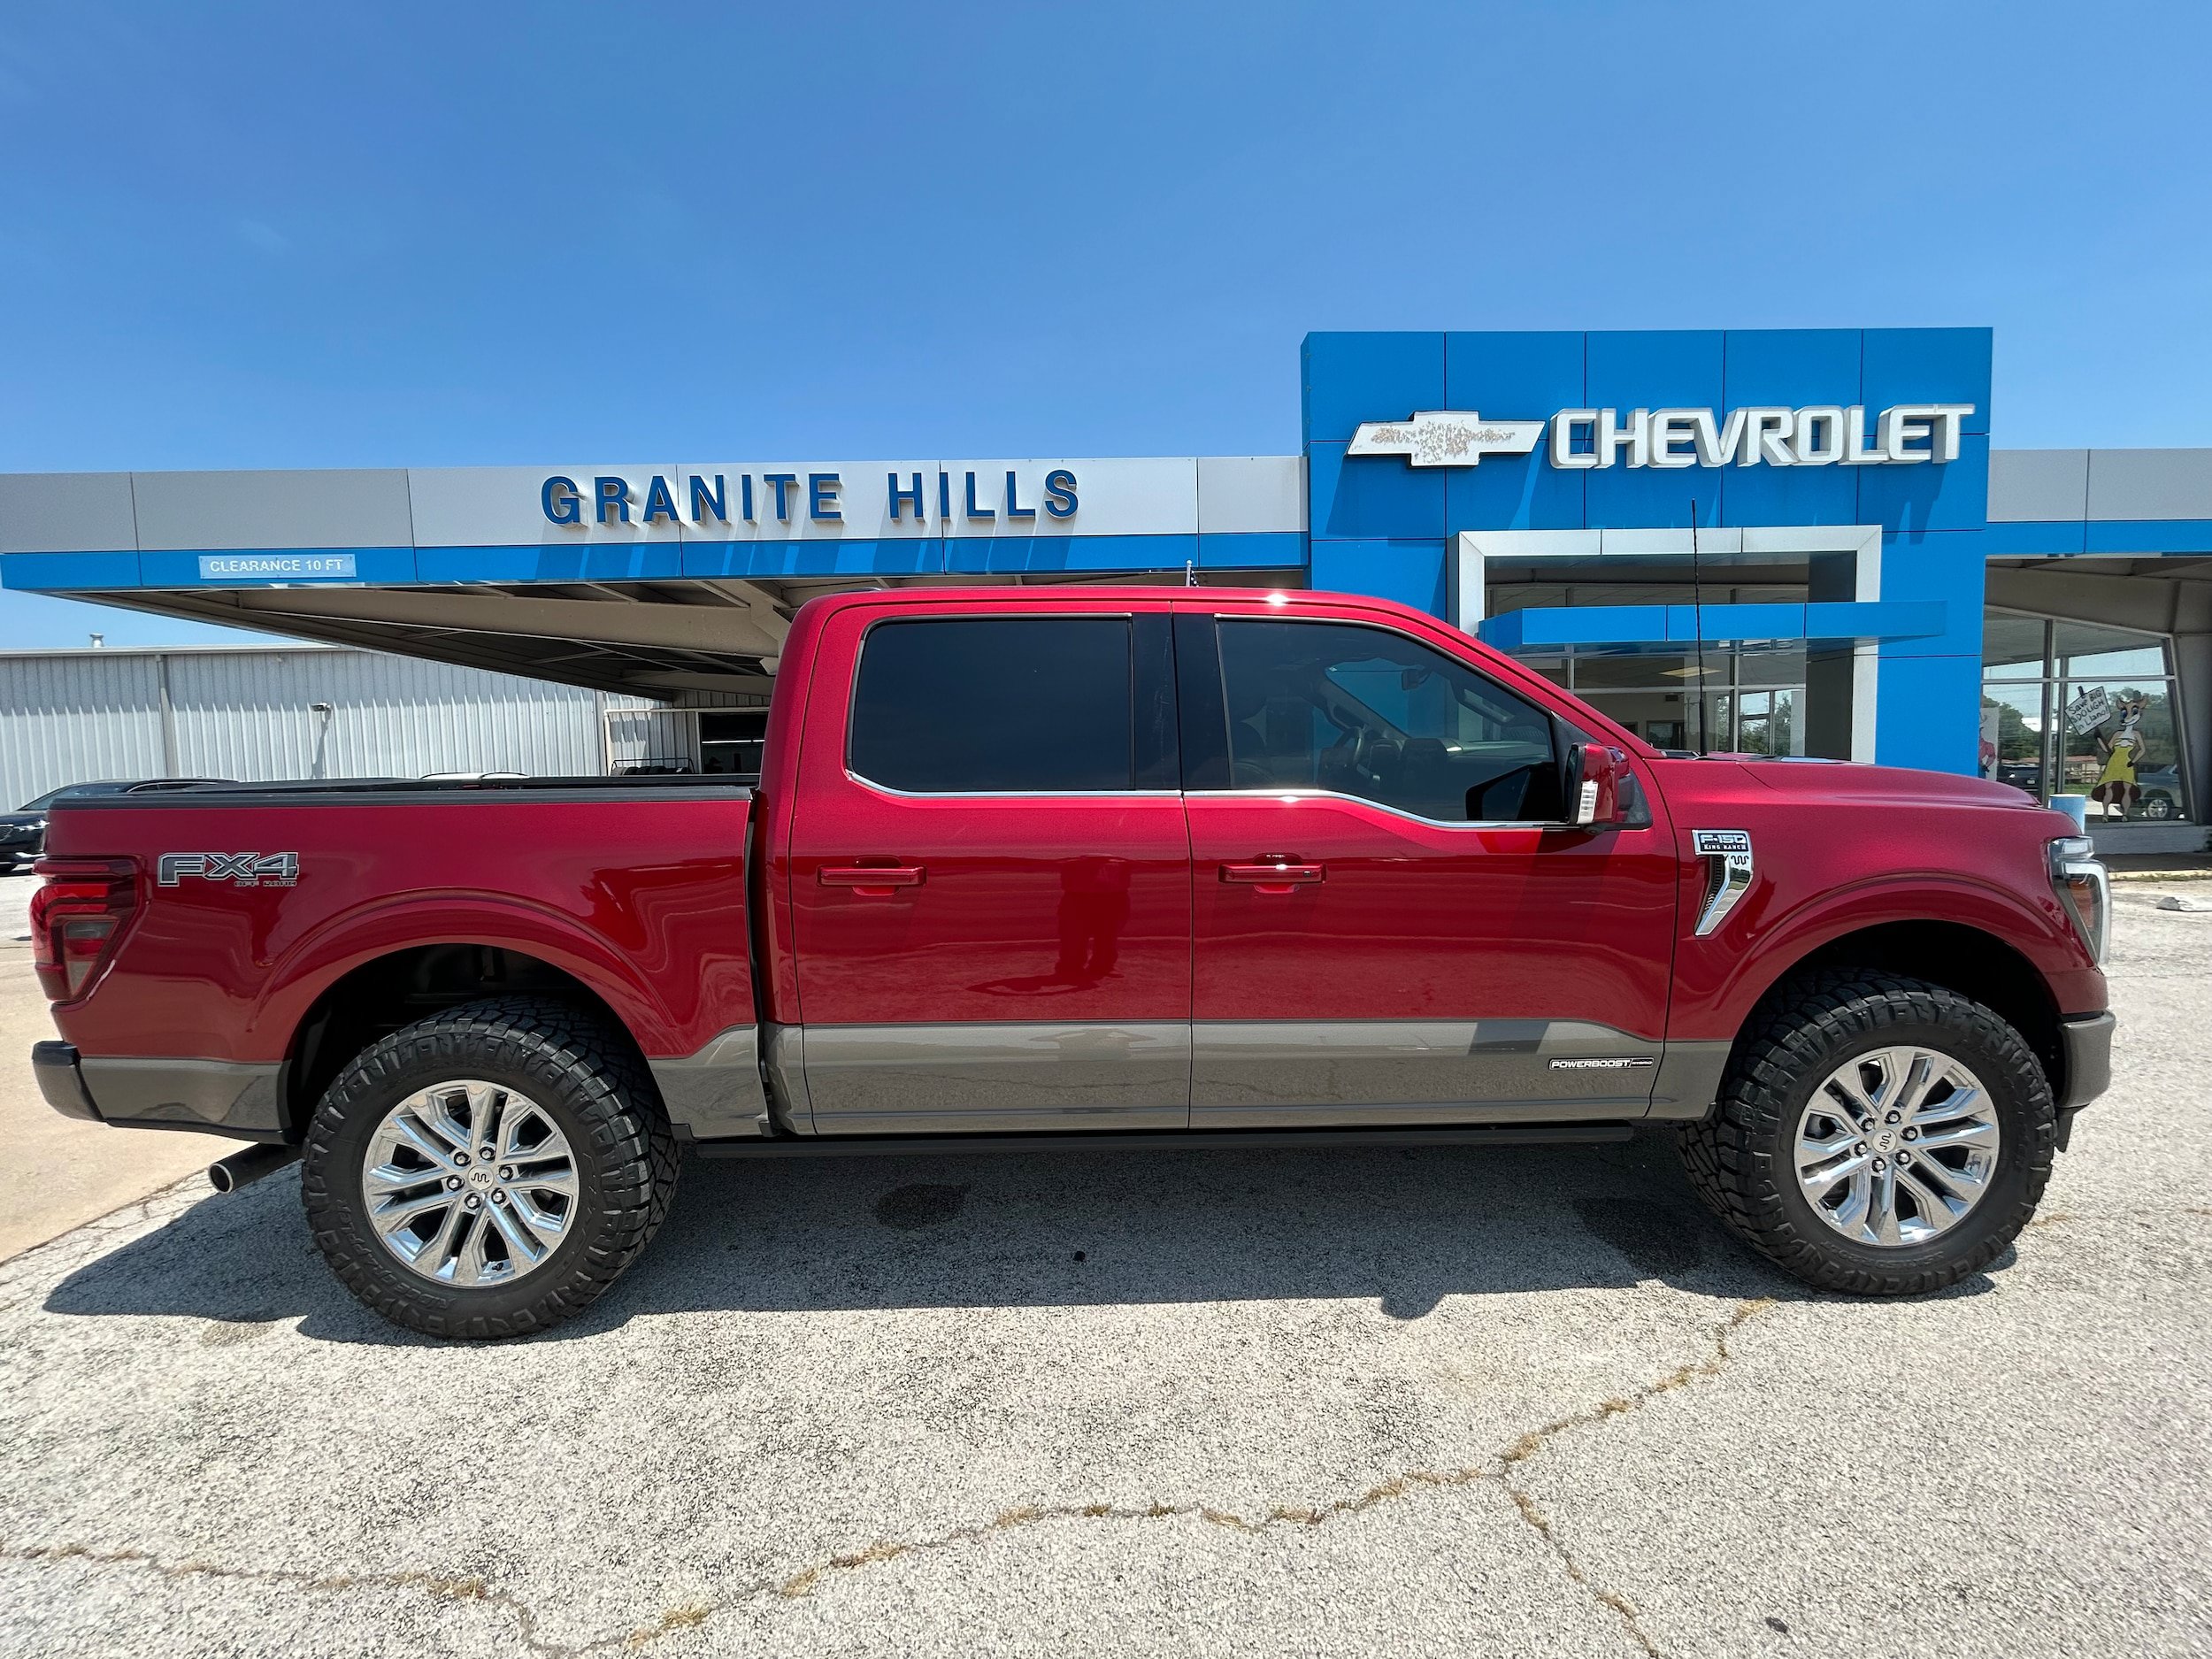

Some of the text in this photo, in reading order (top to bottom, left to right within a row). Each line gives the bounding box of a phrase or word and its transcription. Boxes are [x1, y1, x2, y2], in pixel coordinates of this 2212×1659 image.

[1549, 404, 1975, 470] CHEVROLET
[541, 469, 1079, 526] GRANITE HILLS
[210, 558, 343, 572] CLEARANCE 10 FT
[2089, 689, 2102, 702] BIG
[1700, 834, 1747, 843] F-150
[157, 852, 299, 887] FX4
[1551, 1059, 1631, 1069] POWERBOOST
